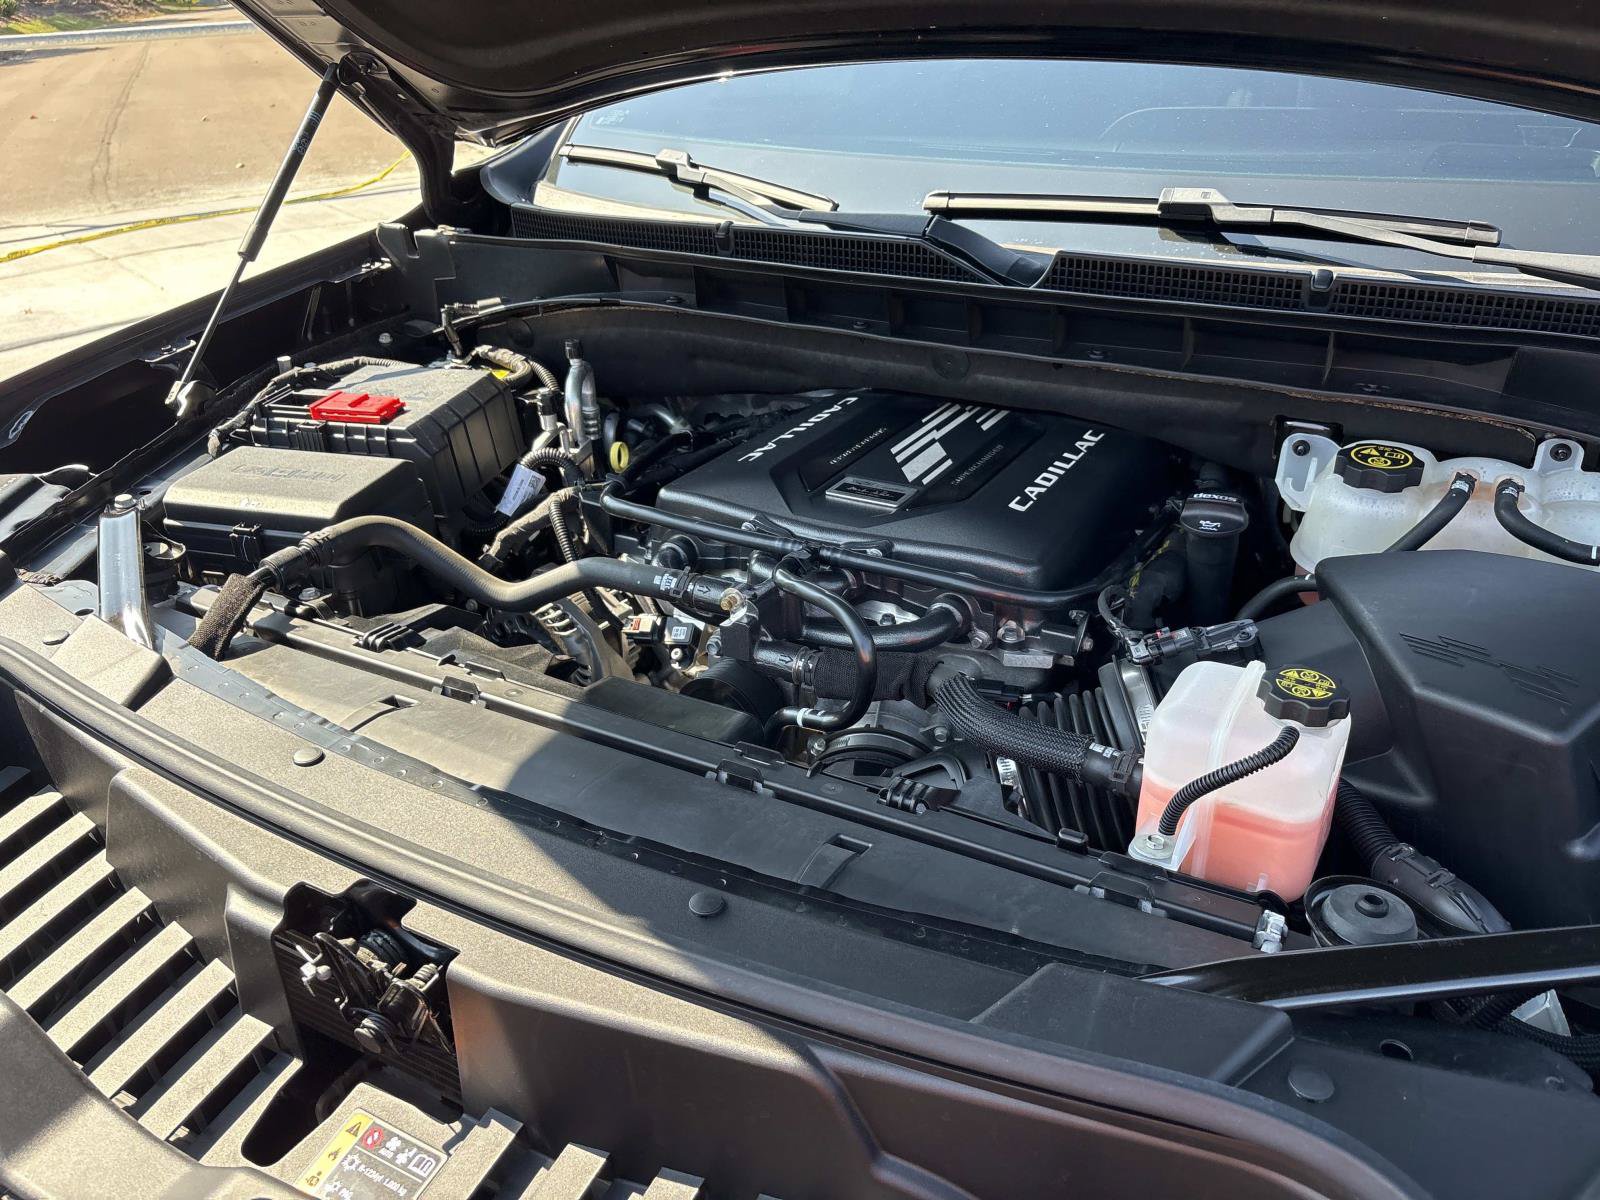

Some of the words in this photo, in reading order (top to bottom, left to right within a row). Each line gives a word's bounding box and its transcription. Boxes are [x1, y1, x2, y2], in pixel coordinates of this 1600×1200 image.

[737, 397, 859, 462] CADILLAC
[1007, 429, 1106, 512] CADILLAC
[1193, 492, 1237, 502] dexos
